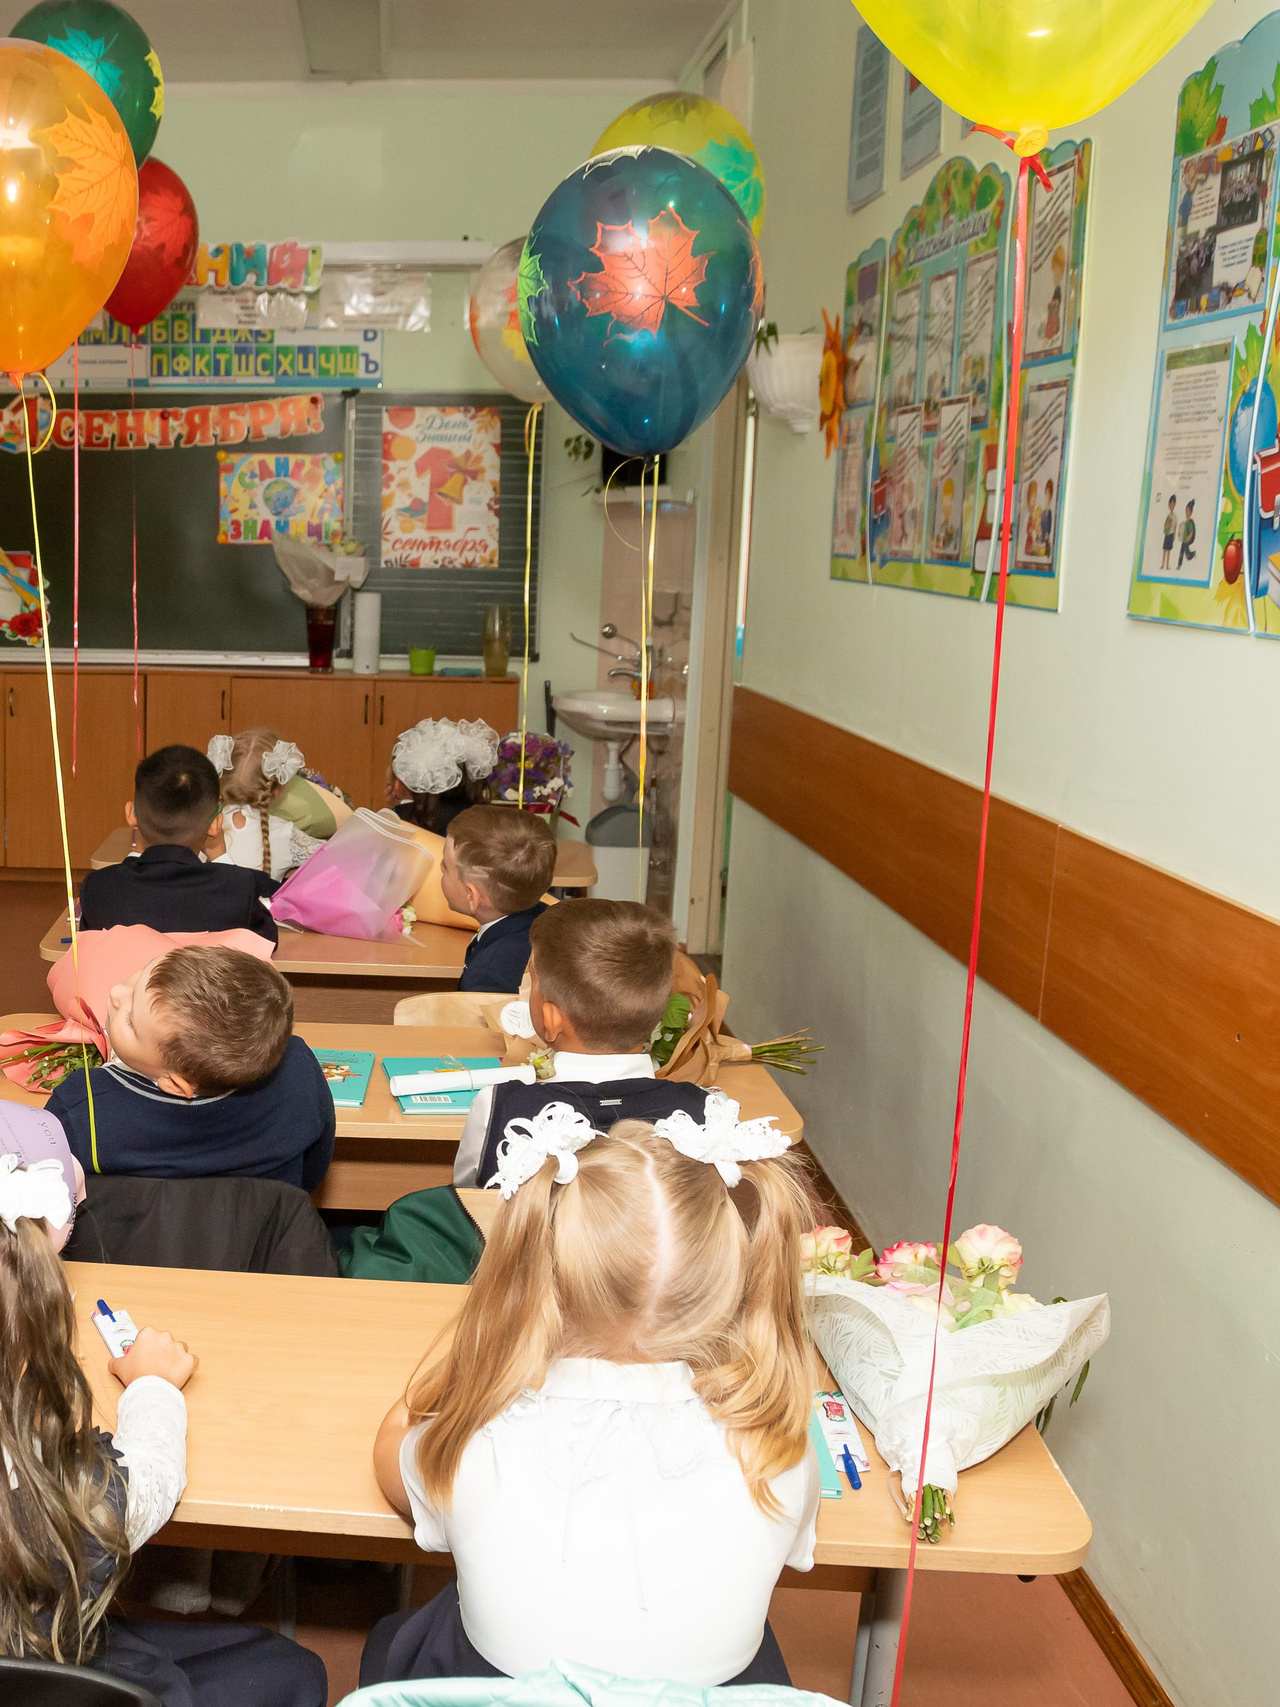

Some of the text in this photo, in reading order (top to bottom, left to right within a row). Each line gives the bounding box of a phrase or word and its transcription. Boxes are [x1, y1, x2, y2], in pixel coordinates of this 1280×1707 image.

[51, 394, 324, 449] СЕНТЯБРЯ!
[414, 446, 455, 532] 1
[391, 527, 489, 557] сентября
